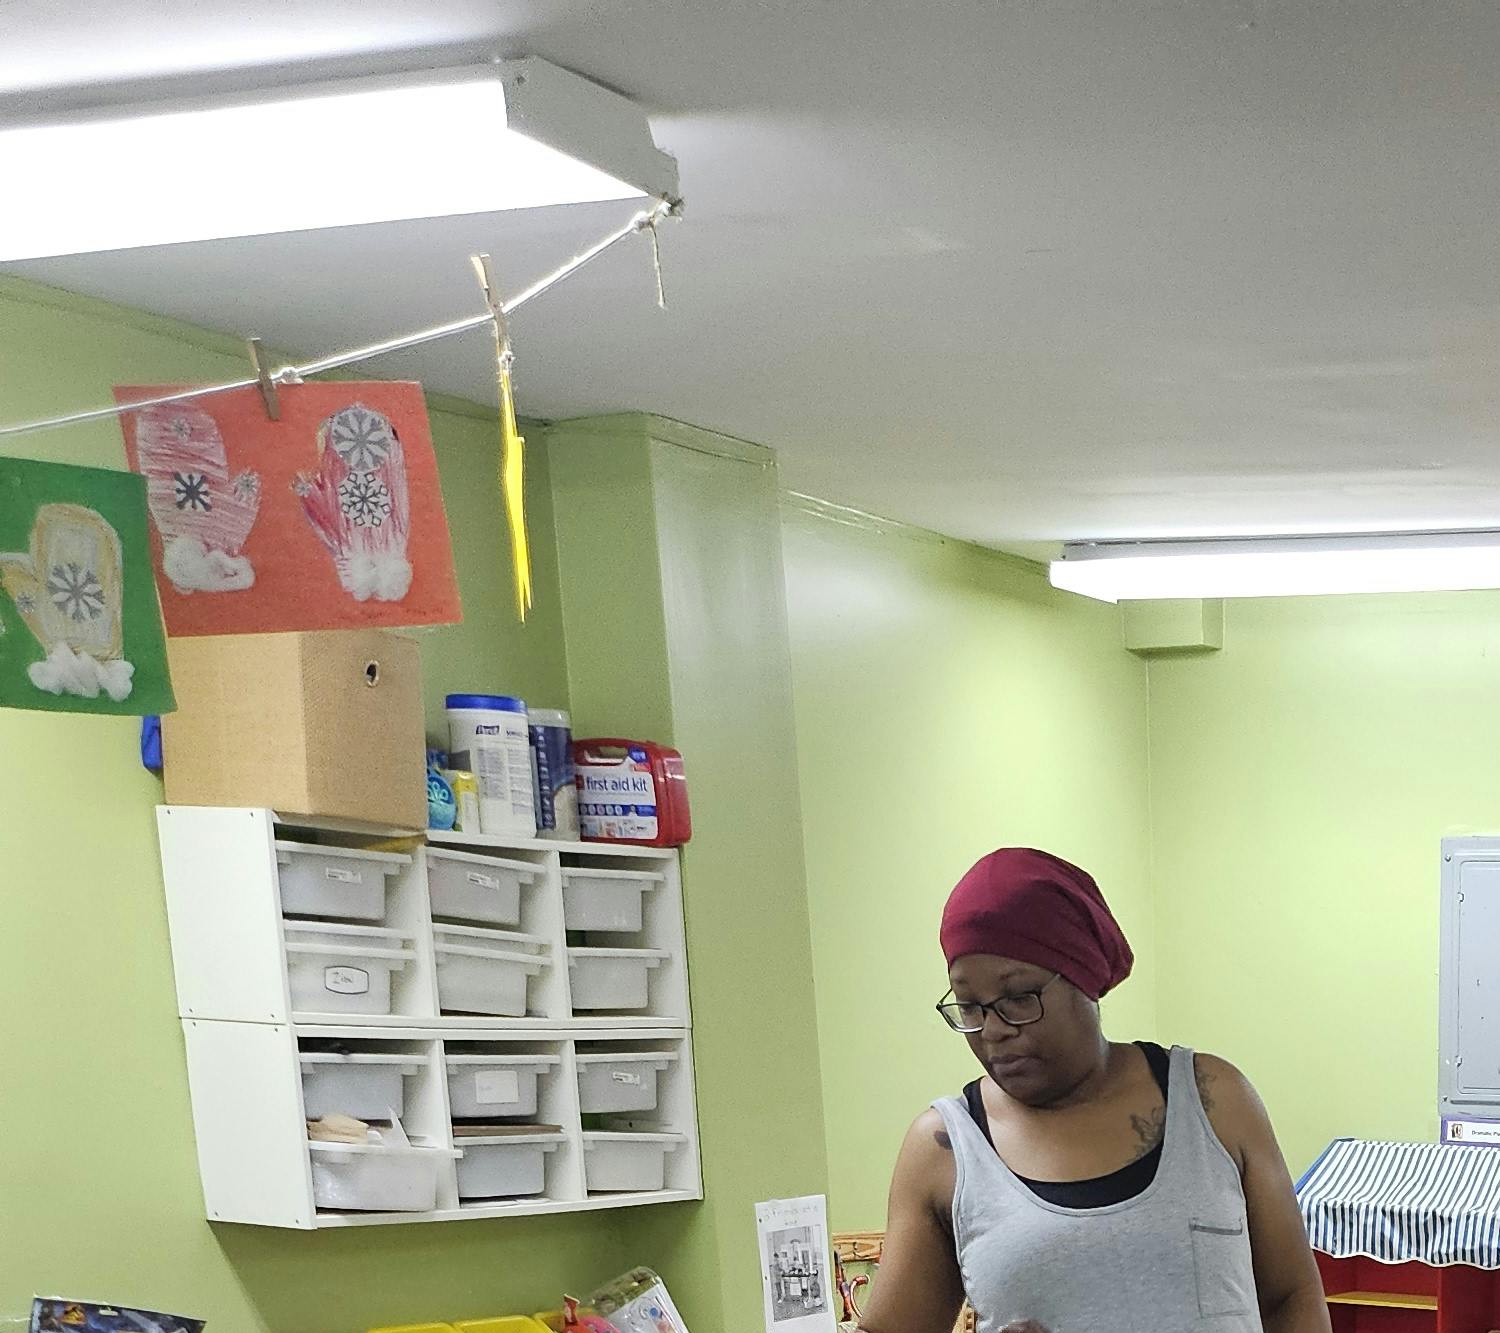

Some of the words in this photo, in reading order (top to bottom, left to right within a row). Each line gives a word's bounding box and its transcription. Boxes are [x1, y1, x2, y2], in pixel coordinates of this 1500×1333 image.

[586, 775, 609, 791] first
[612, 776, 630, 792] aid
[633, 778, 649, 793] kit
